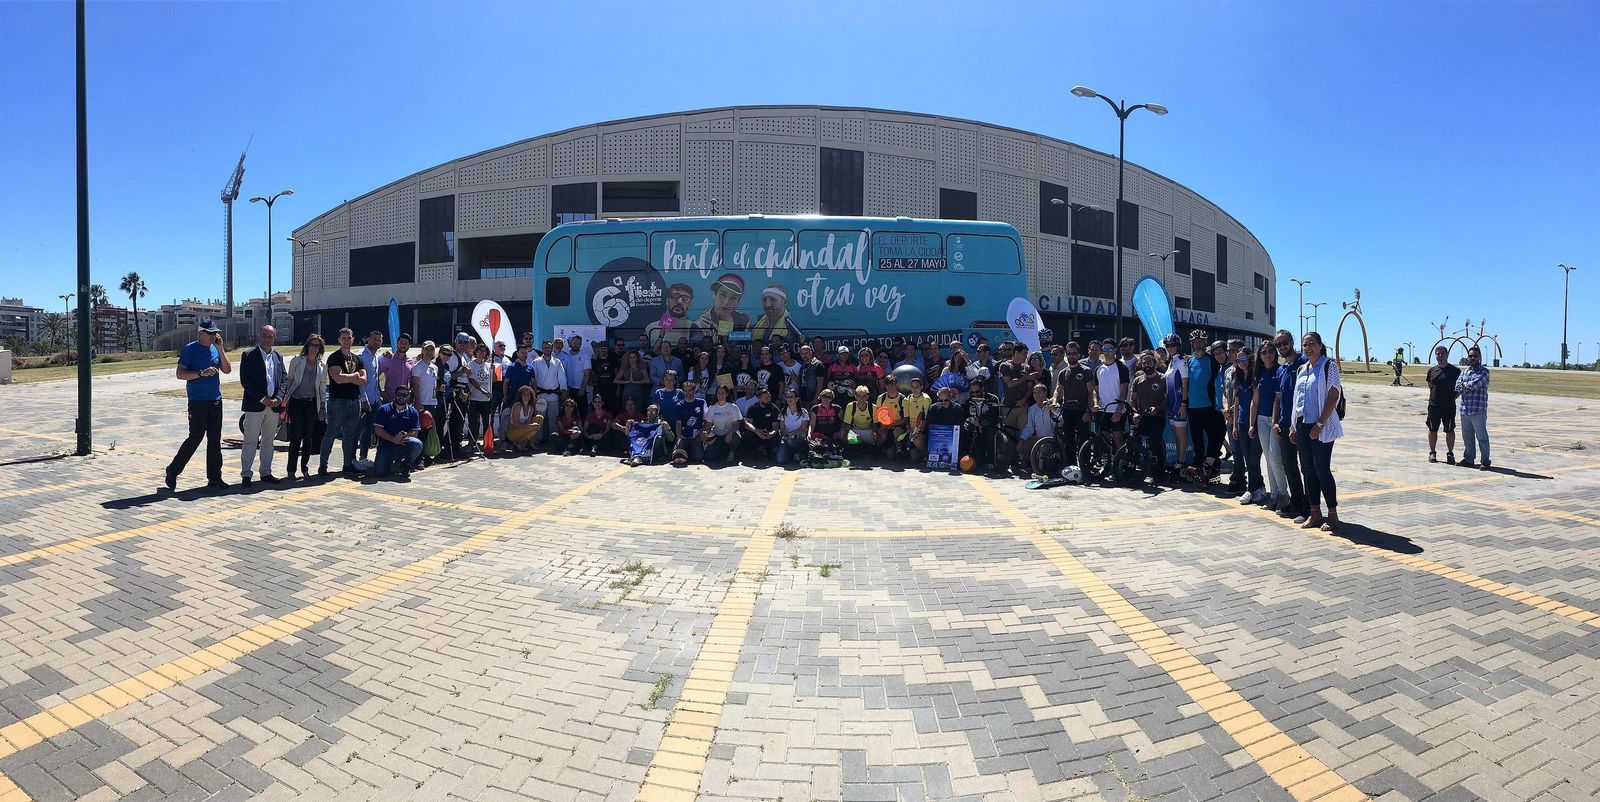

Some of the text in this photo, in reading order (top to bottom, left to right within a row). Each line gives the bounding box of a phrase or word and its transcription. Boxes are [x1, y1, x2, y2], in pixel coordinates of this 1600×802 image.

[879, 236, 928, 246] EL DEPORTE
[663, 238, 722, 279] Ponte
[733, 243, 749, 269] el
[879, 247, 904, 257] TOMA
[906, 247, 916, 257] LA
[918, 247, 946, 257] CIUDA
[880, 259, 892, 269] 25
[894, 259, 905, 269] AL
[907, 259, 919, 269] 27
[921, 259, 946, 269] MAYO
[797, 272, 906, 322] otra vez
[1039, 295, 1117, 315] CIUDAD
[1173, 308, 1209, 326] ALAGA
